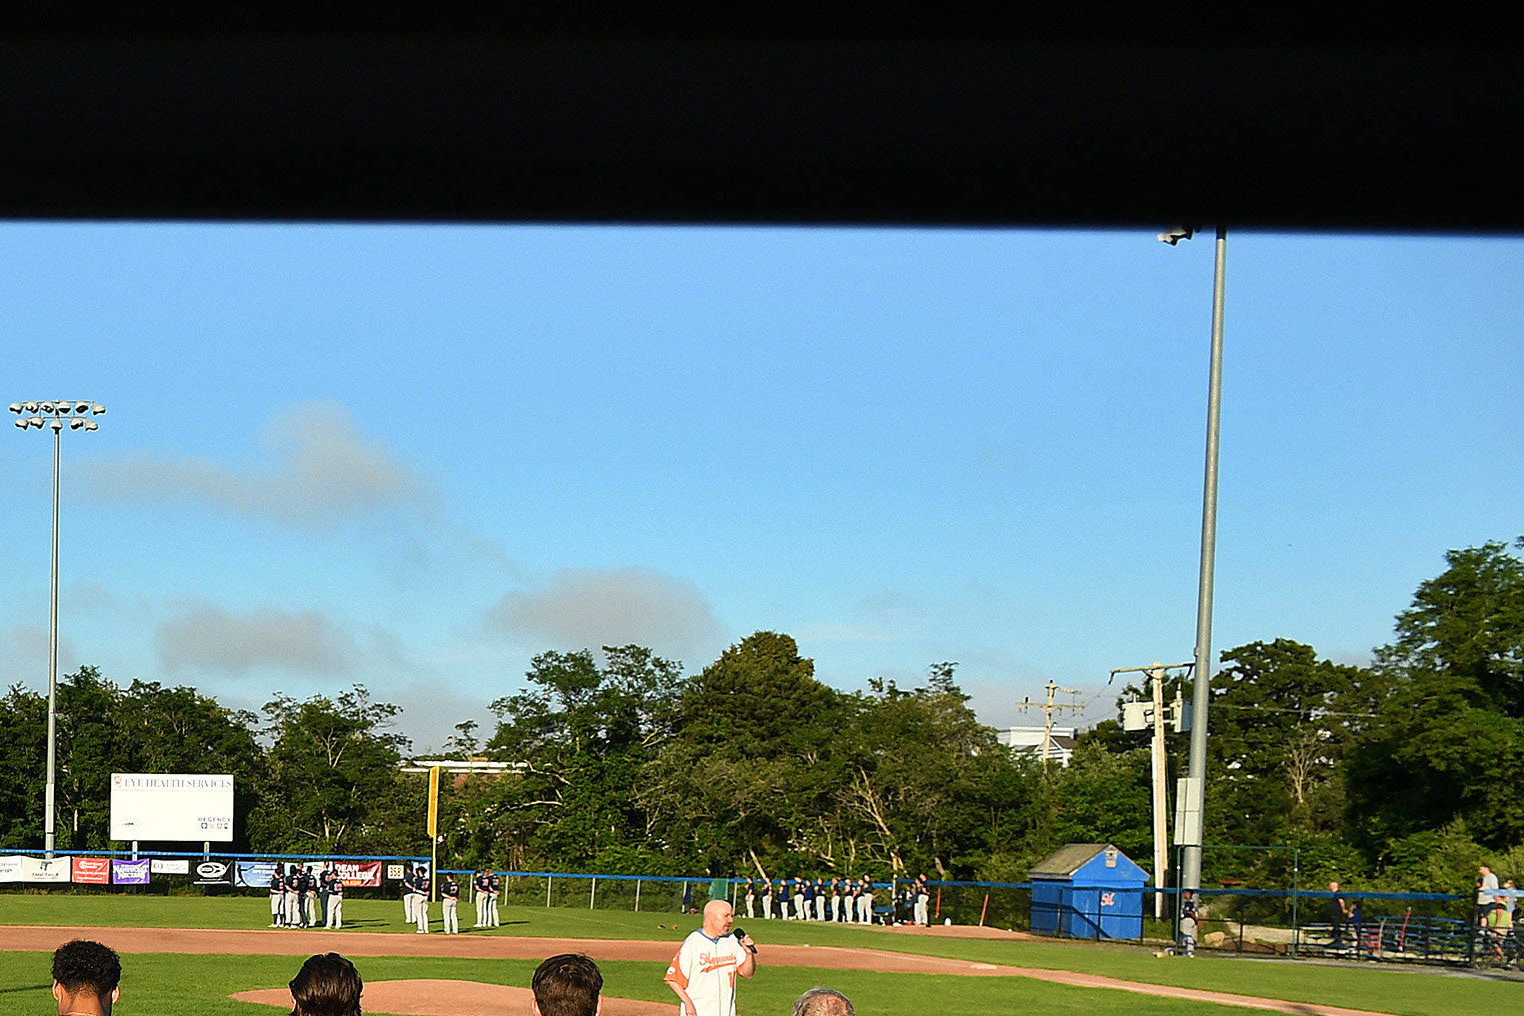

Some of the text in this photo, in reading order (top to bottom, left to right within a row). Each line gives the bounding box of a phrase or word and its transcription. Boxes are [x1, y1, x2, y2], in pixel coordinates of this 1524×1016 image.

[125, 778, 232, 788] EYE HEALTH SERVICES
[335, 864, 359, 872] DEAN
